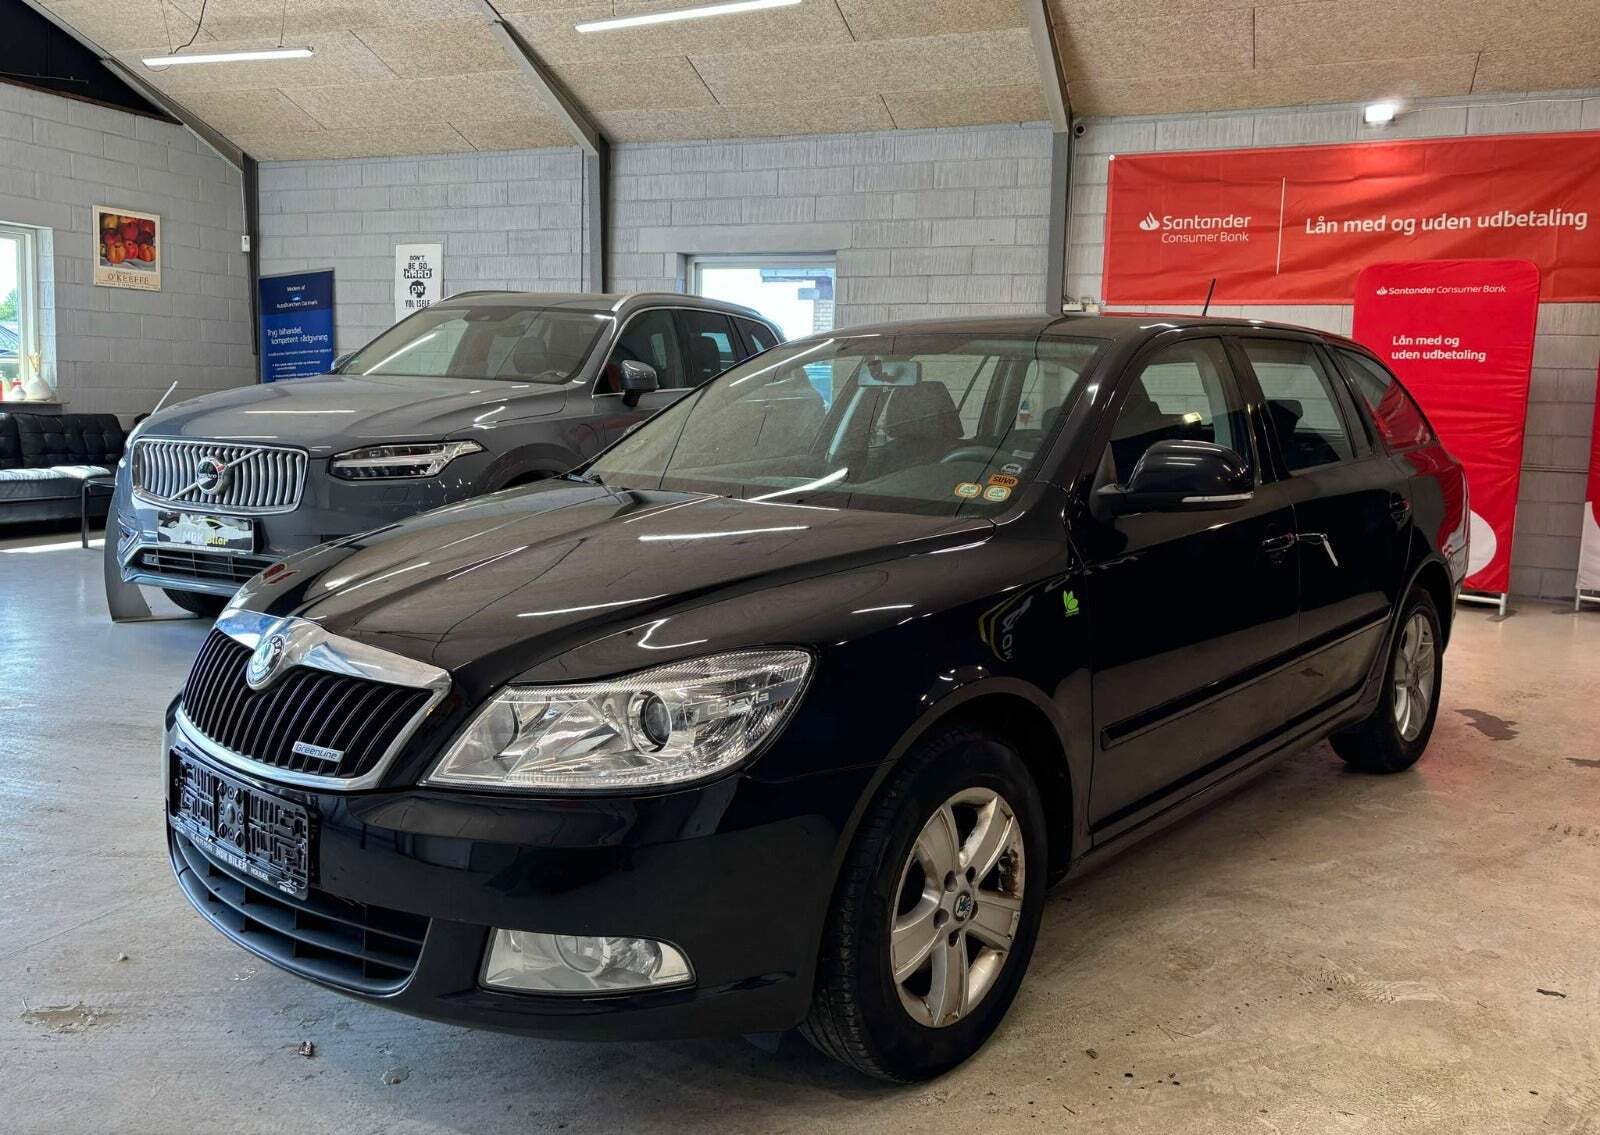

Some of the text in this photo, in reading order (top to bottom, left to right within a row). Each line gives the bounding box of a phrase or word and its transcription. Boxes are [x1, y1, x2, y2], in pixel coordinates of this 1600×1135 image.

[1162, 213, 1252, 231] Santander
[1304, 208, 1589, 237] Lån med og uden udbetaling
[1161, 231, 1249, 244] Consumer Bank
[404, 268, 432, 279] HARD
[411, 284, 425, 294] ON
[1387, 284, 1507, 296] Santander Consumer Bank
[266, 328, 278, 339] Tryg
[1392, 334, 1460, 348] Lån med og
[1391, 349, 1487, 363] uden udbetaling
[228, 854, 248, 873] BILER
